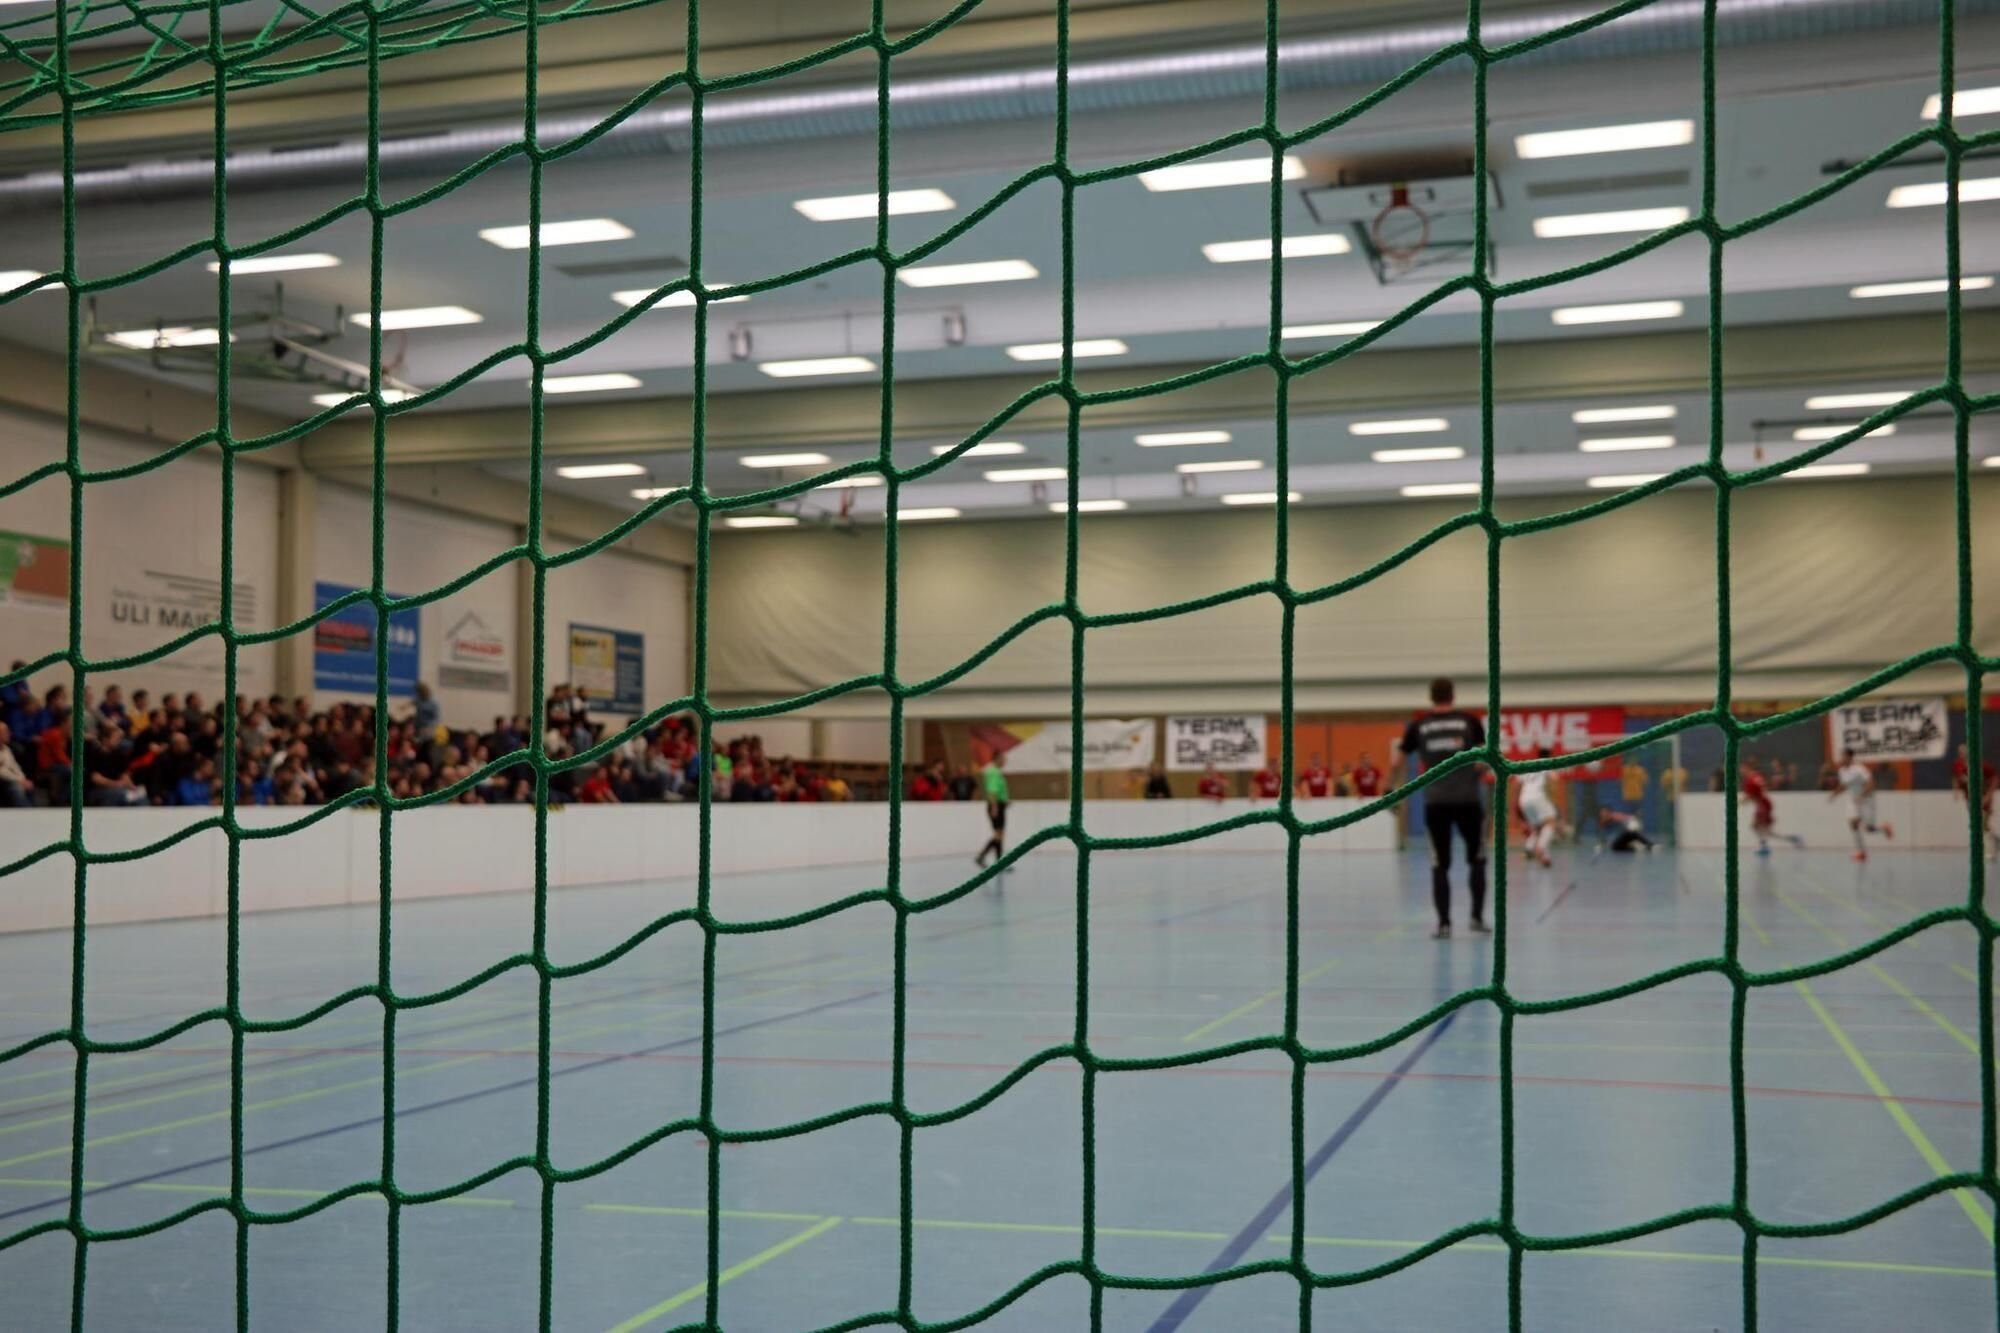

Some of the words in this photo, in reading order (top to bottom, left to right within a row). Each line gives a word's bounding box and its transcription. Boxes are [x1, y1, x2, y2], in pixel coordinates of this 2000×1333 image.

[111, 602, 150, 625] ULI
[1840, 704, 1922, 723] TEAM
[1174, 717, 1246, 734] TEAM
